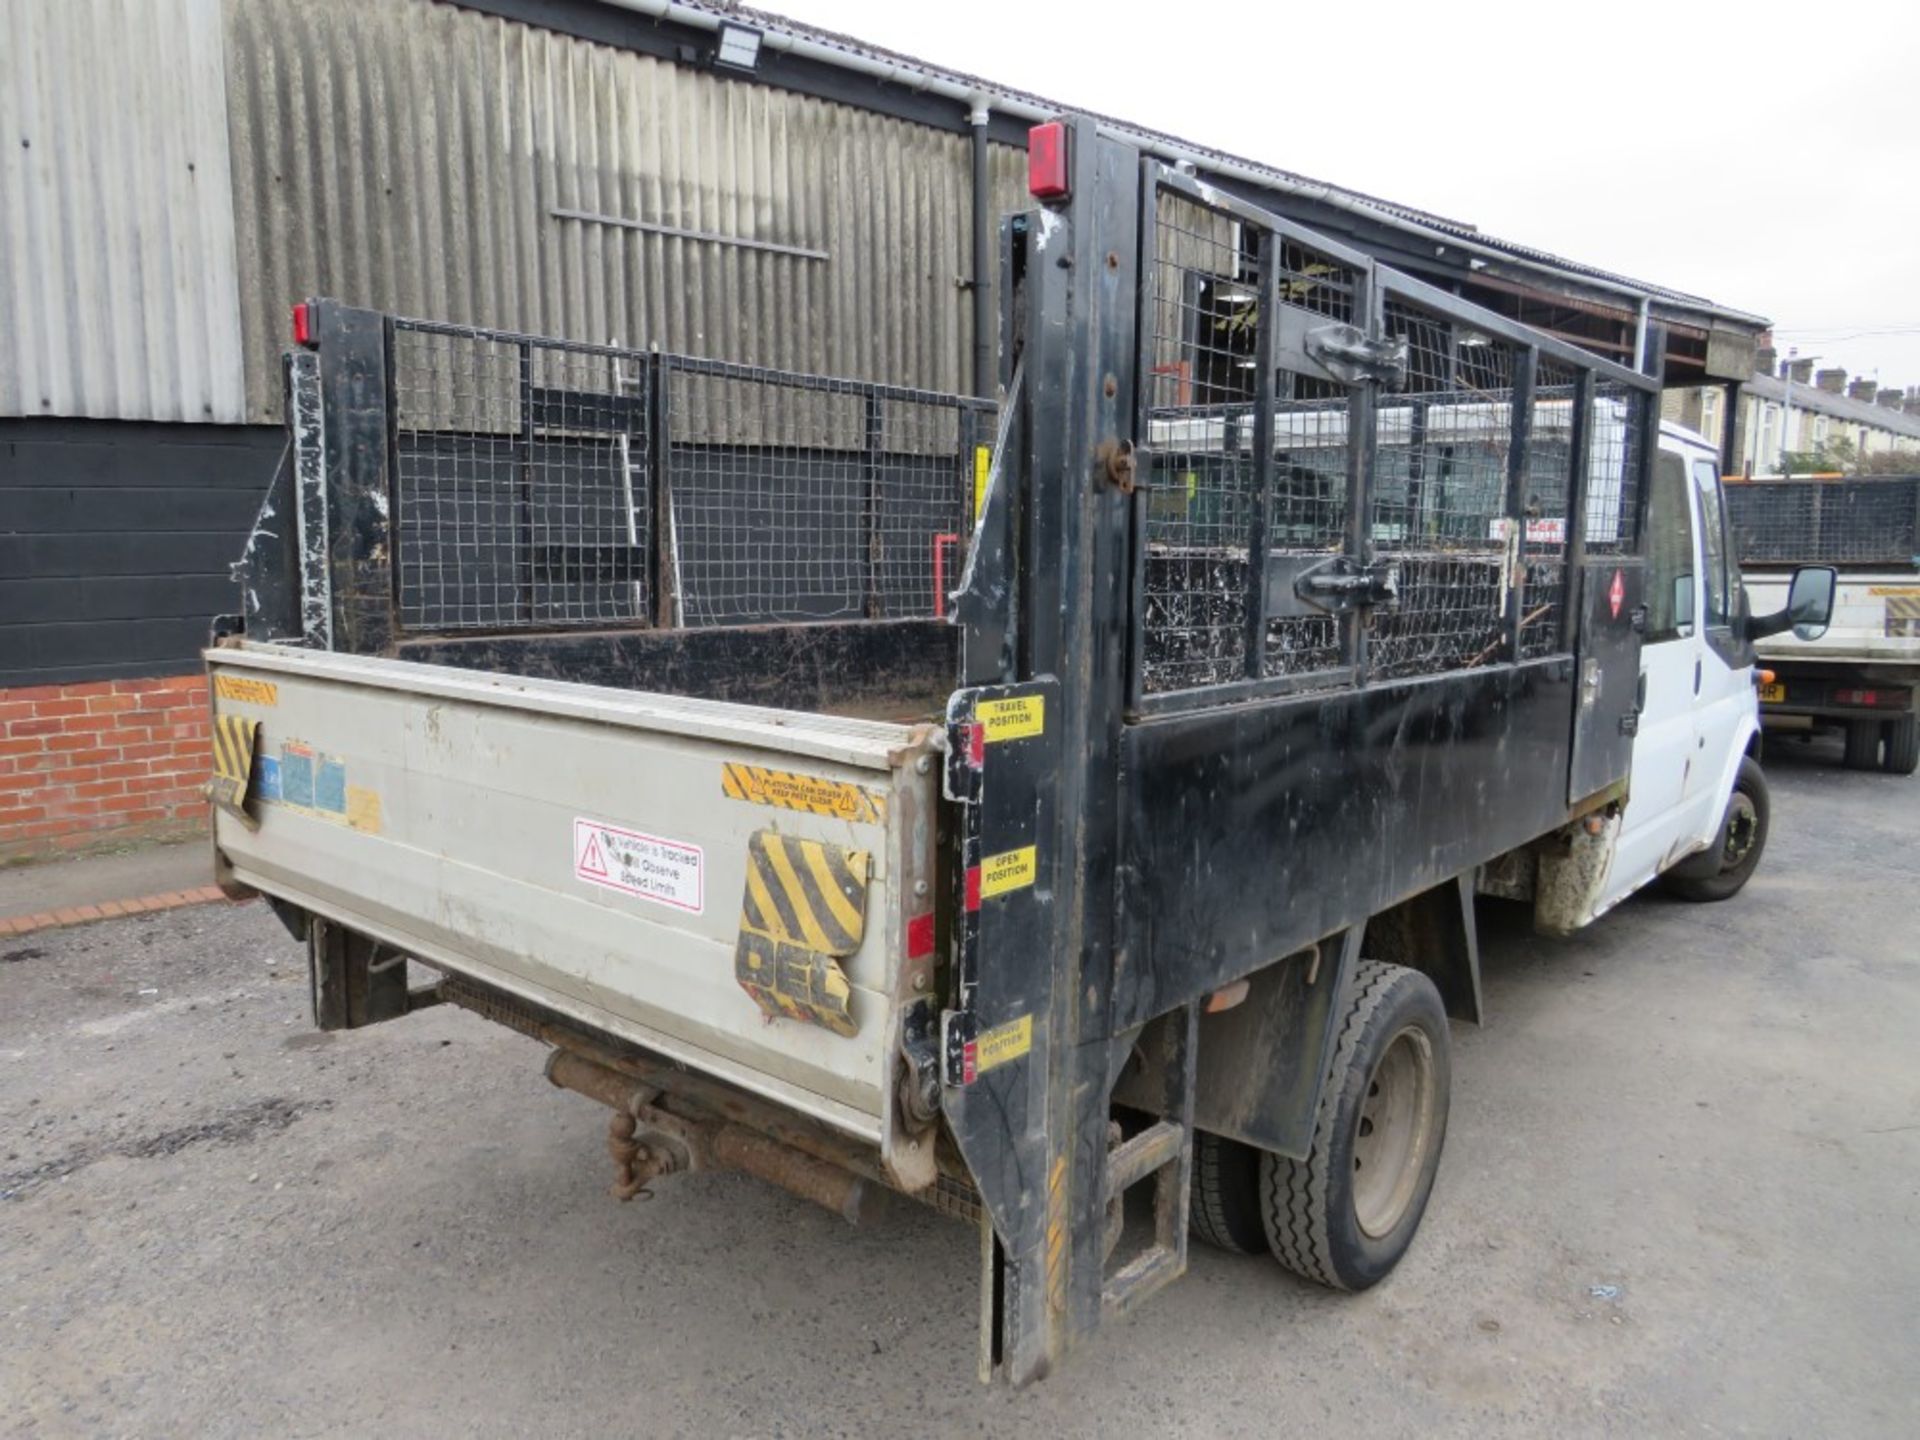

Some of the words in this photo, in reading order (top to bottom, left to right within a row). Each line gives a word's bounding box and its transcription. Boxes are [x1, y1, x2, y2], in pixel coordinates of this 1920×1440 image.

[994, 700, 1027, 712] TRAVEL
[988, 713, 1032, 727] POSITION
[660, 846, 698, 867] Tracked
[996, 853, 1020, 867] OPEN
[642, 859, 681, 880] Observe
[986, 863, 1028, 883] POSITION
[620, 870, 649, 889] Speed
